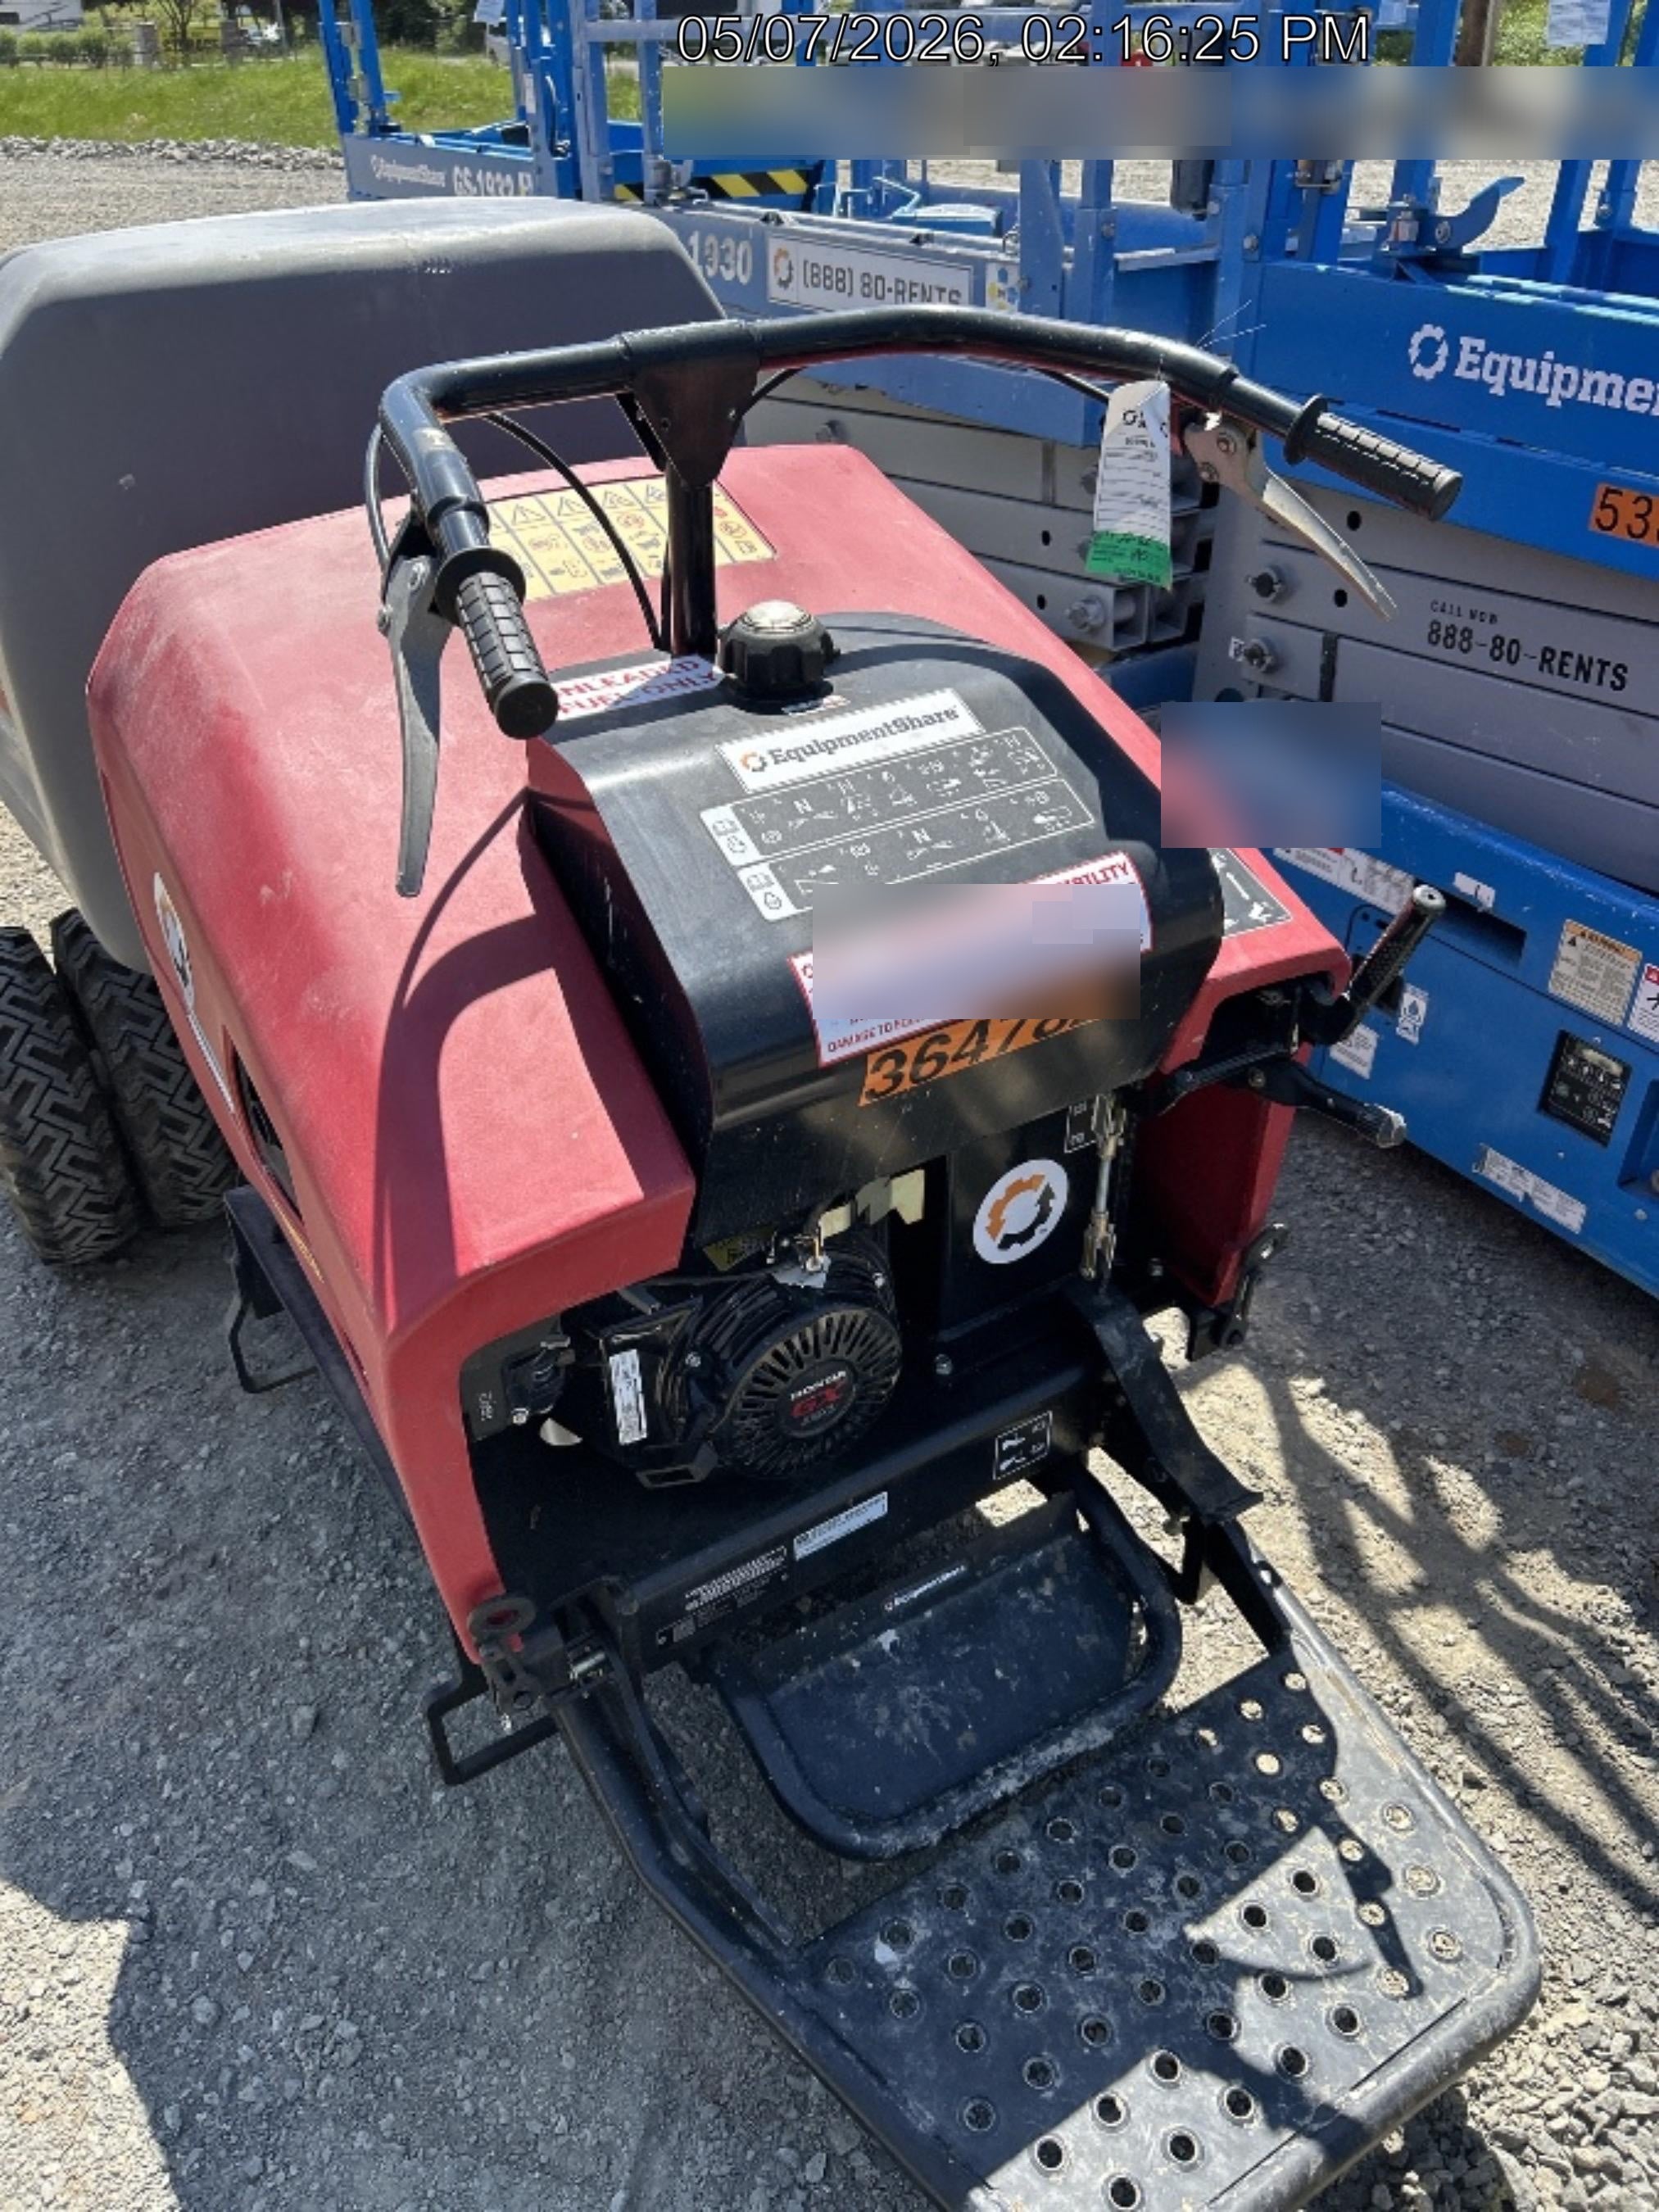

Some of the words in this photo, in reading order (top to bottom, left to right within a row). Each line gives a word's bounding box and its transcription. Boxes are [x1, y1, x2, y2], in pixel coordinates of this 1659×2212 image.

[803, 259, 853, 298] (888)
[1454, 336, 1659, 416] Equipme
[1594, 487, 1659, 542] 53
[1427, 619, 1629, 691] 888-80-RENTS
[768, 705, 960, 765] EquipmentShare
